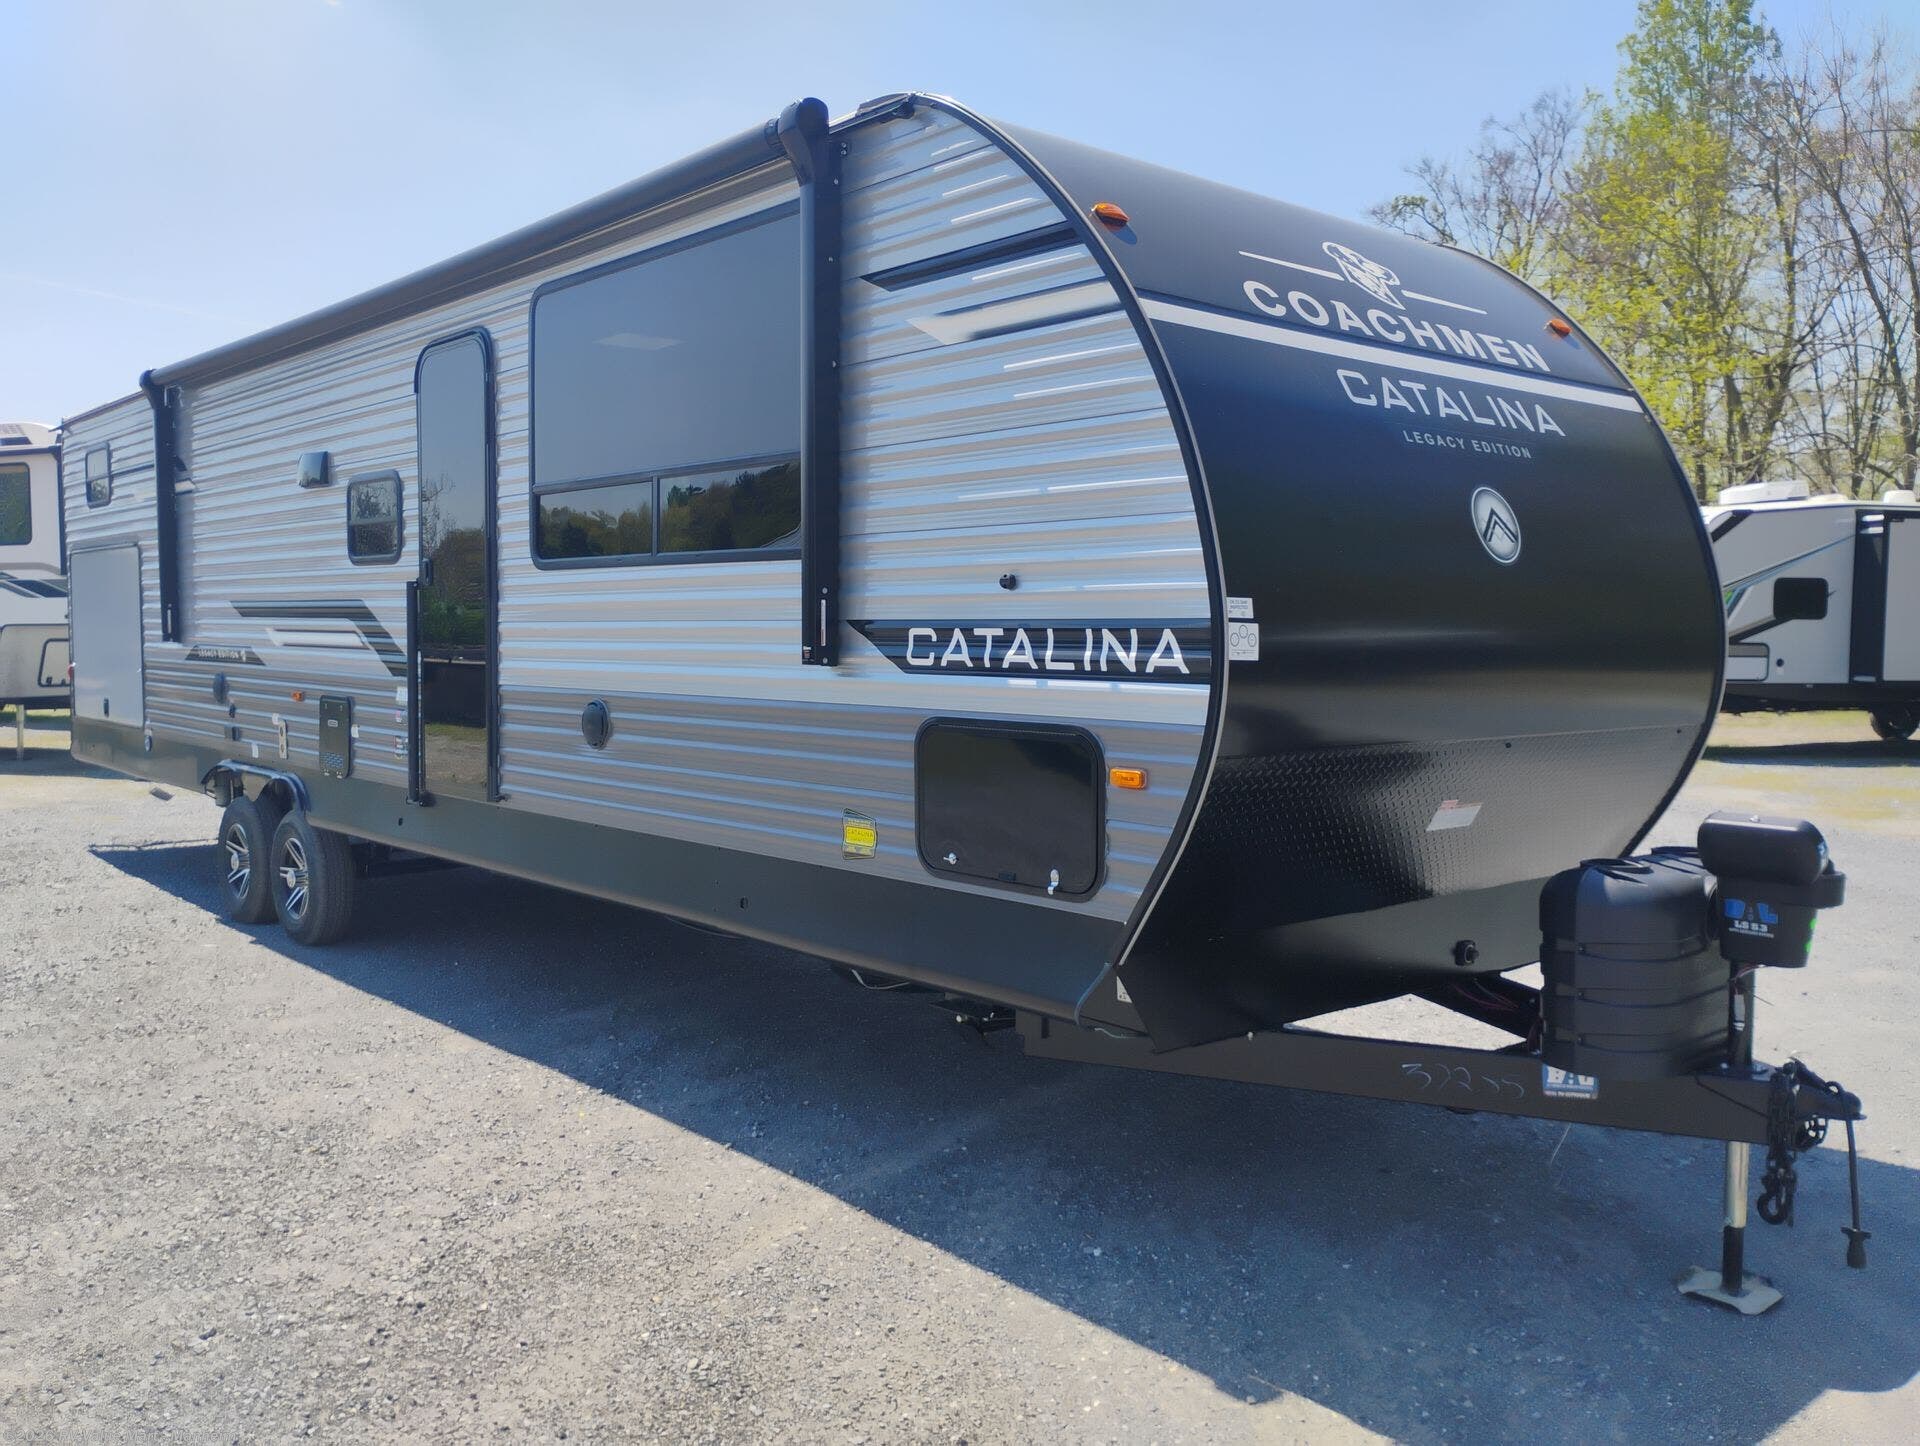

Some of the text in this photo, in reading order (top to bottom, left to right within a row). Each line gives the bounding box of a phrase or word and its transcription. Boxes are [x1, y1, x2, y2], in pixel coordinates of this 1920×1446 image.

[1243, 280, 1551, 372] COACHMEN
[1336, 368, 1566, 437] CATALINA
[1403, 430, 1532, 459] LEGACY EDITION
[907, 627, 1190, 675] CATALINA
